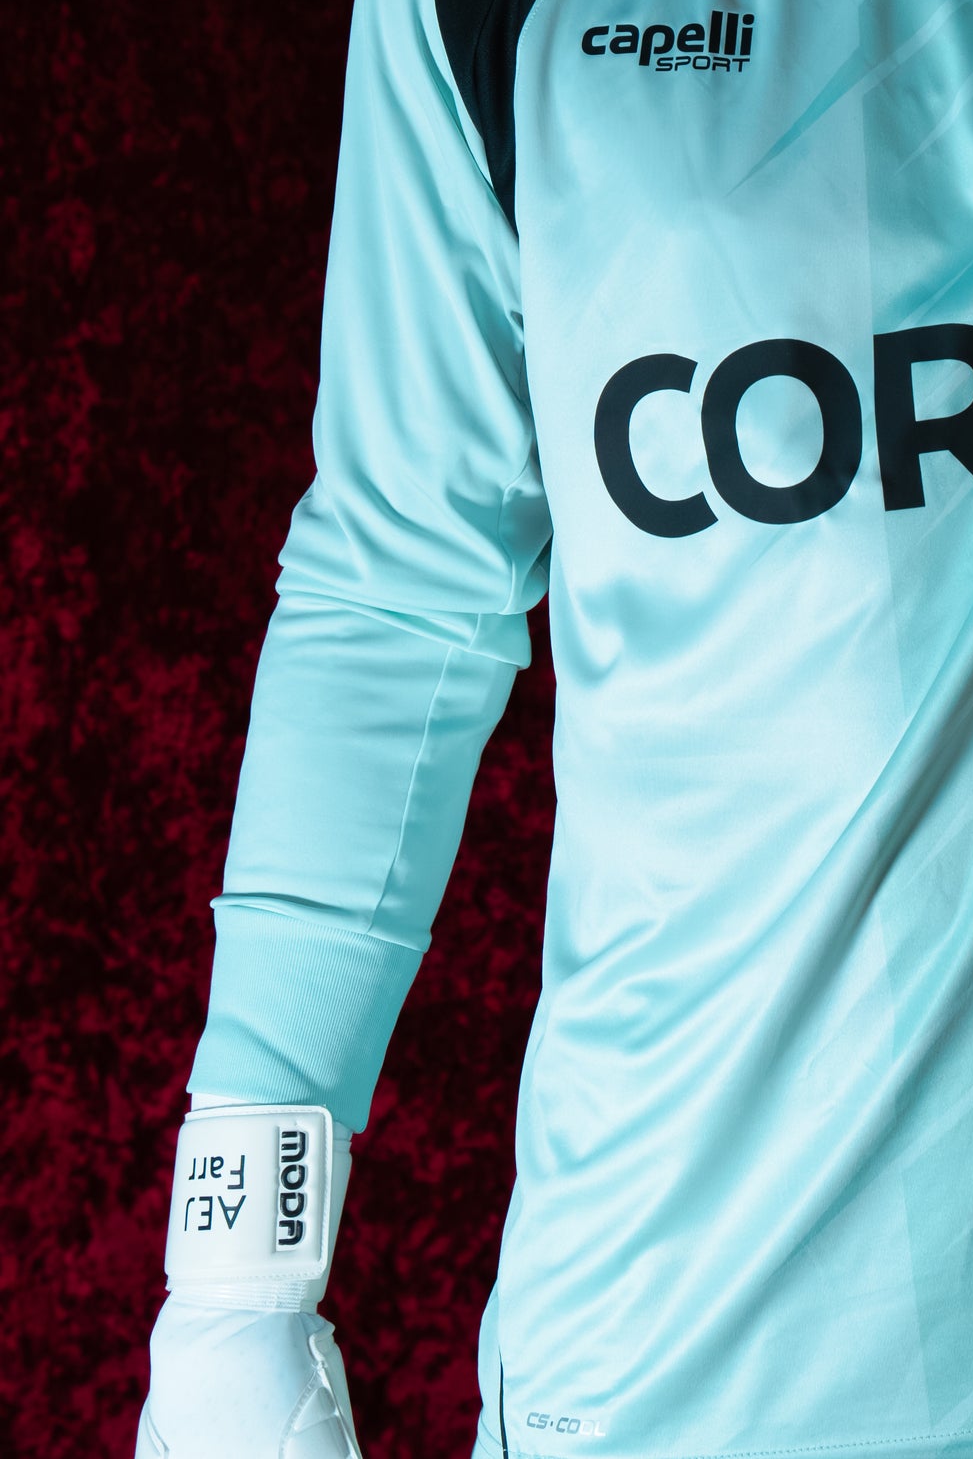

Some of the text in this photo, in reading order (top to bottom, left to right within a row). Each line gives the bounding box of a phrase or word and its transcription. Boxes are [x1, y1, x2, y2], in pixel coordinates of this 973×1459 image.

[581, 10, 755, 66] capelli
[655, 55, 751, 73] SPORT
[188, 1154, 246, 1190] Farr
[183, 1195, 246, 1232] AEJ
